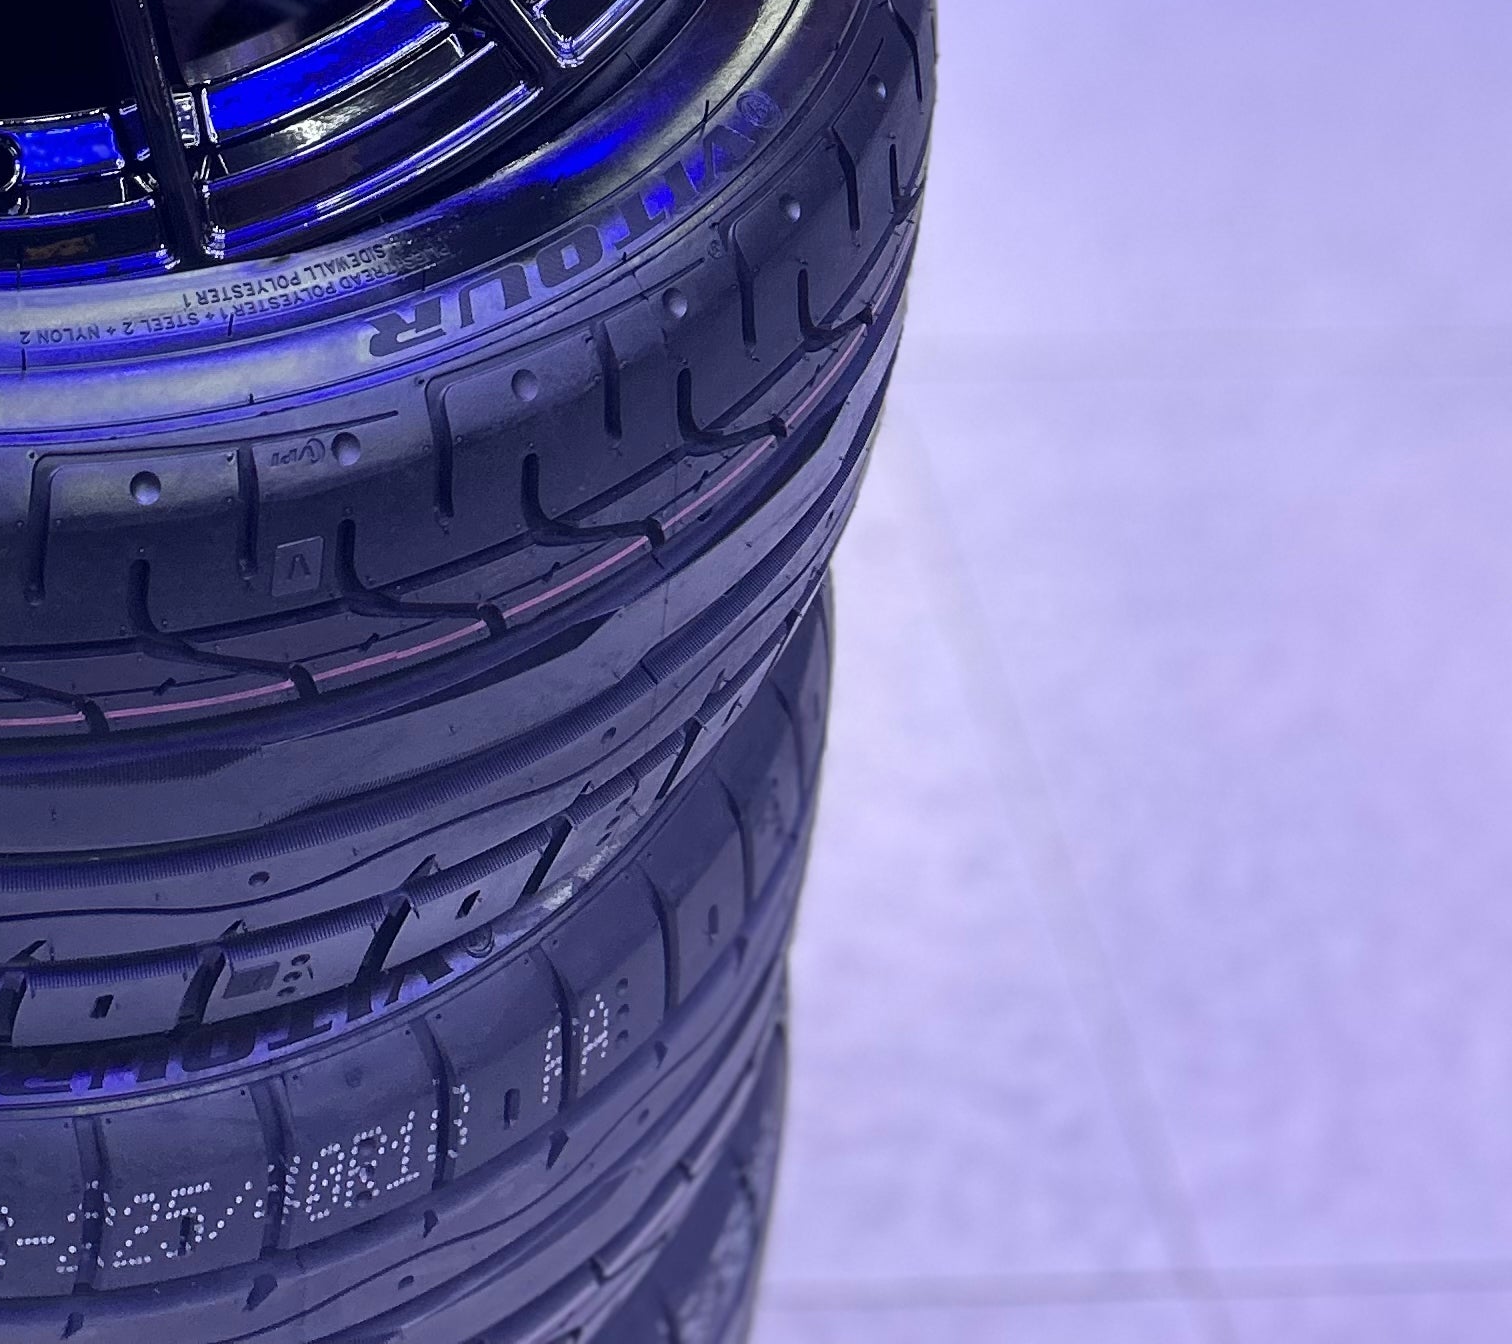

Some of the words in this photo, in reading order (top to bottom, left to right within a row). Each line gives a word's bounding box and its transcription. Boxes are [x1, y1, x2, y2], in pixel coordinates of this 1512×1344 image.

[368, 125, 758, 358] VITOUR
[301, 239, 387, 284] SIDEWALL
[337, 258, 394, 292] TREAD
[180, 292, 192, 310] 1
[194, 265, 302, 310] POLYESTER
[230, 275, 337, 321] POLYESTER
[34, 322, 100, 344] NYLON
[120, 320, 134, 336] 2
[139, 308, 200, 334] STEEL
[18, 329, 31, 344] 2
